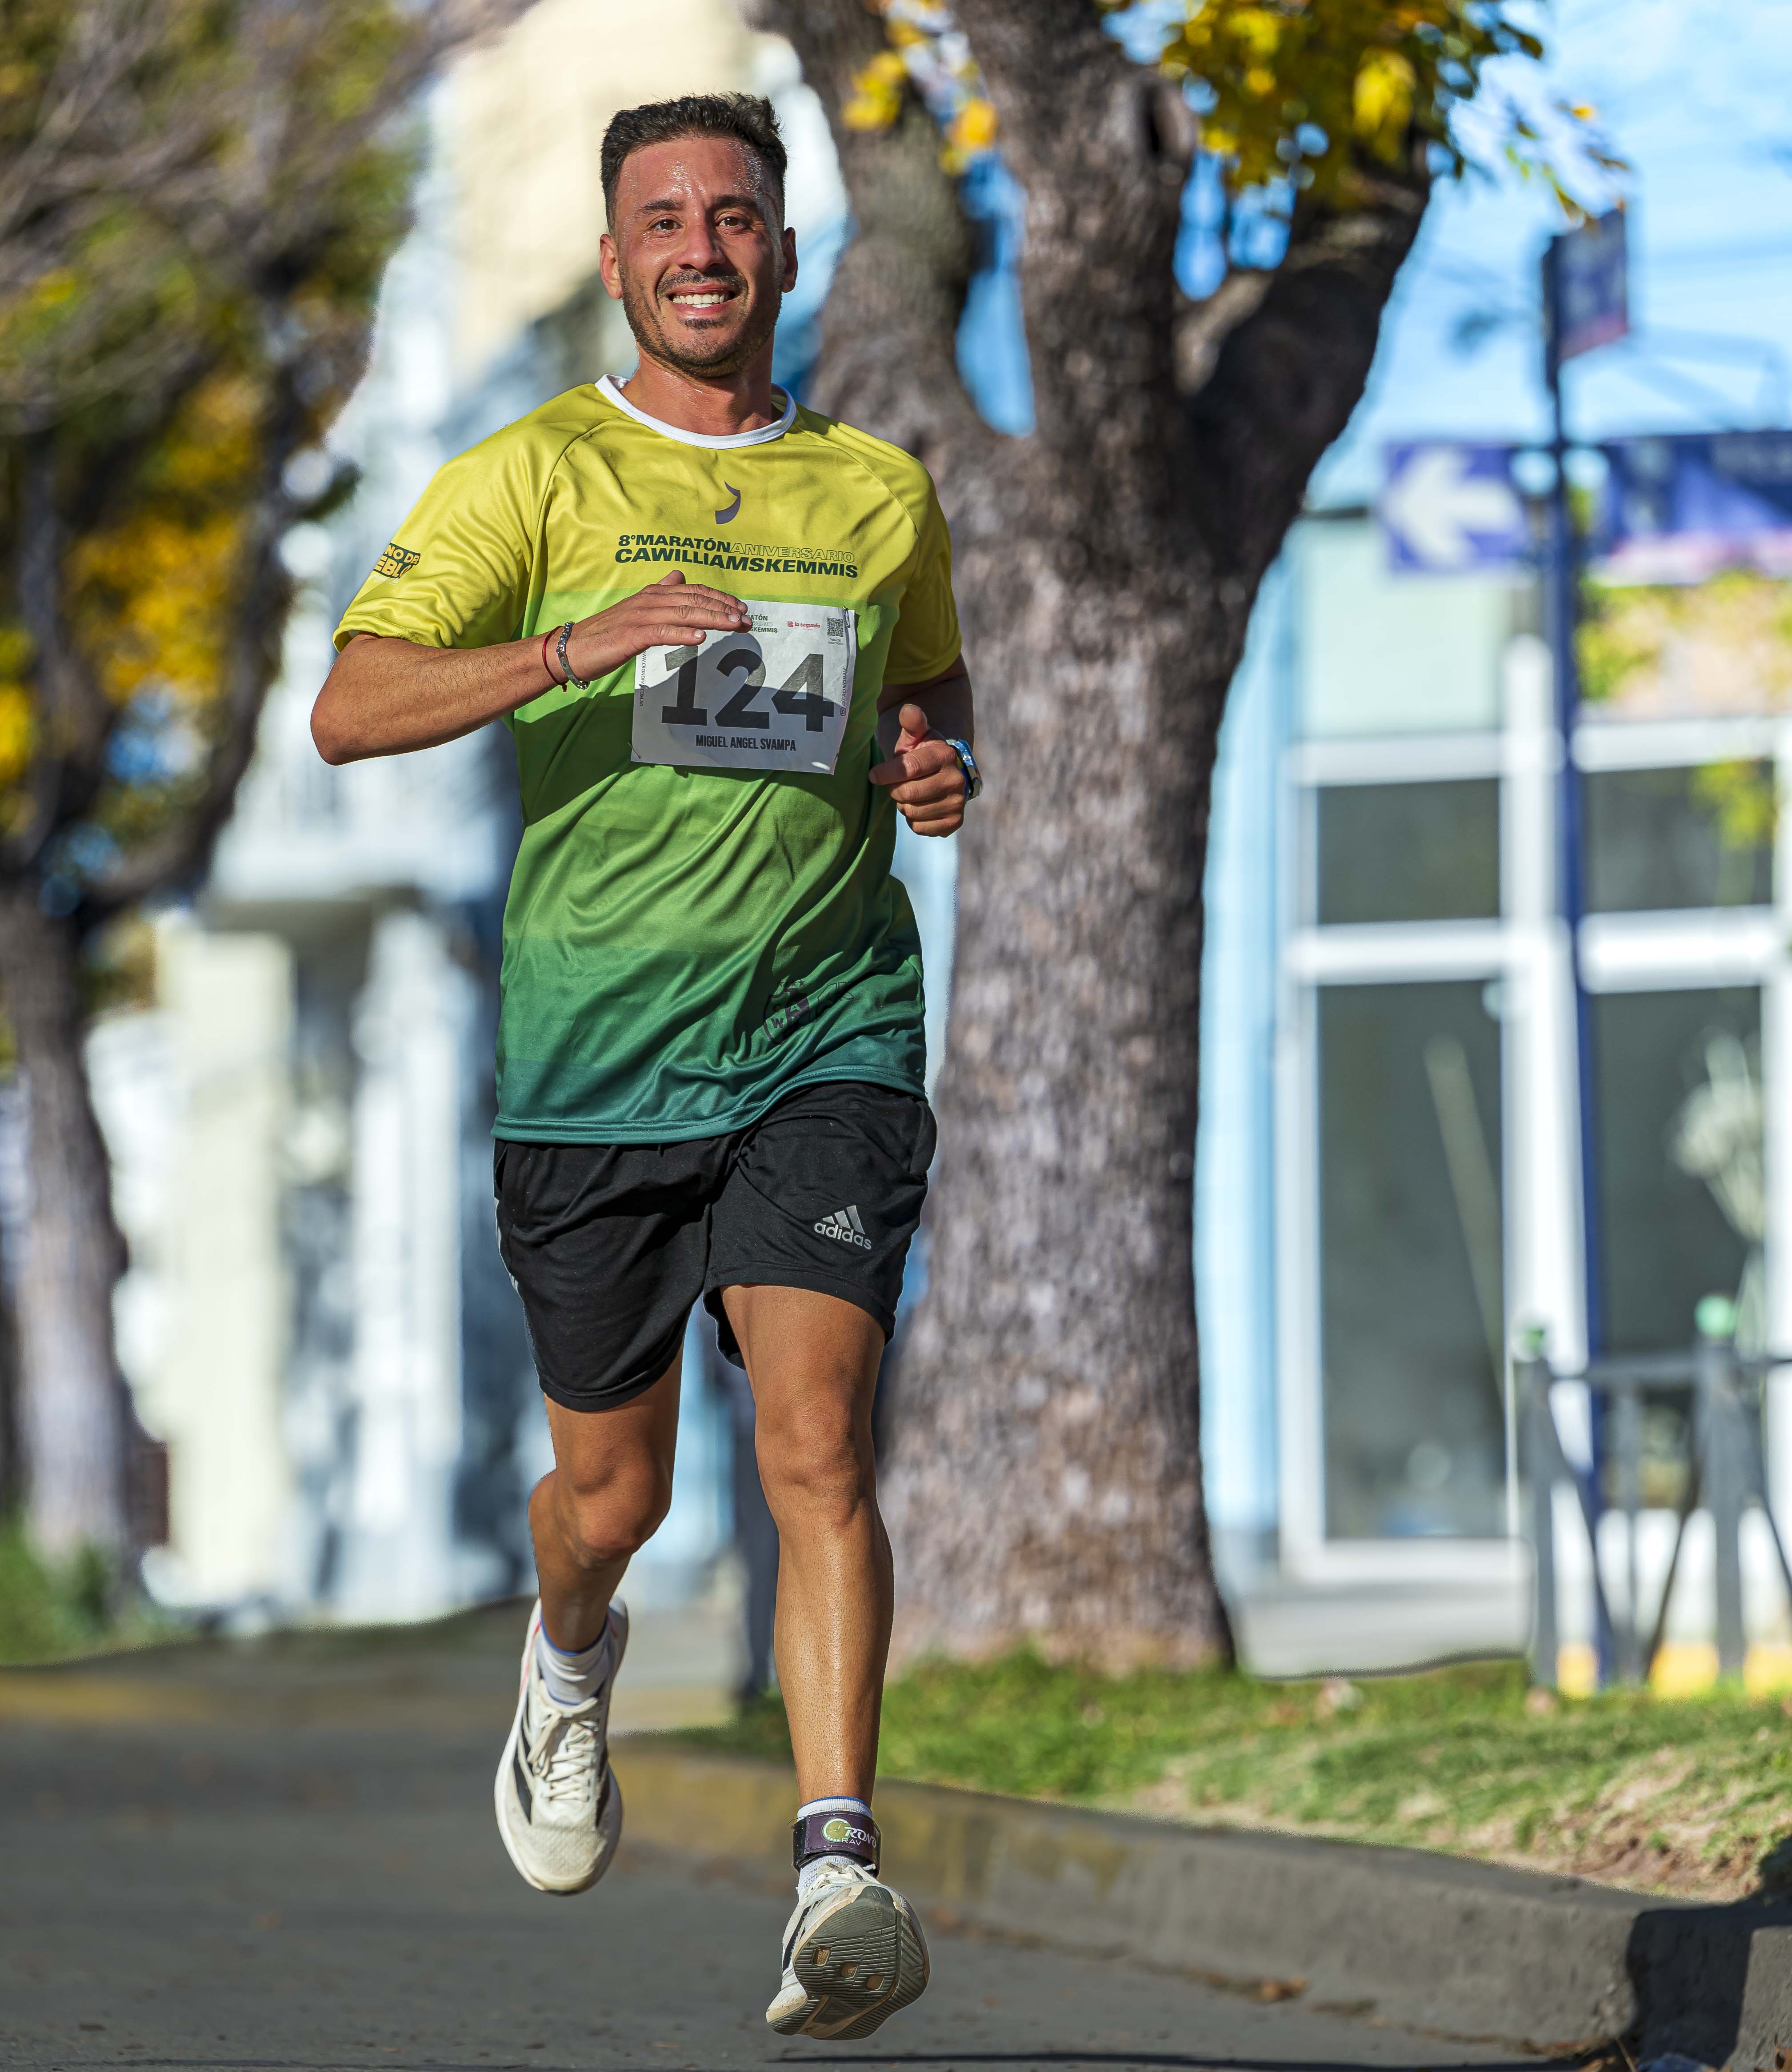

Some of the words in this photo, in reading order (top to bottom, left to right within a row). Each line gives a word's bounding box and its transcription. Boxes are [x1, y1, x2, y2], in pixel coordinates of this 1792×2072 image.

[661, 646, 834, 732] 124
[696, 735, 728, 748] MIGUEL
[730, 737, 759, 749] ANGEL
[760, 738, 796, 751] SVAMPA
[814, 1223, 872, 1250] adidas
[841, 1837, 861, 1846] RAV
